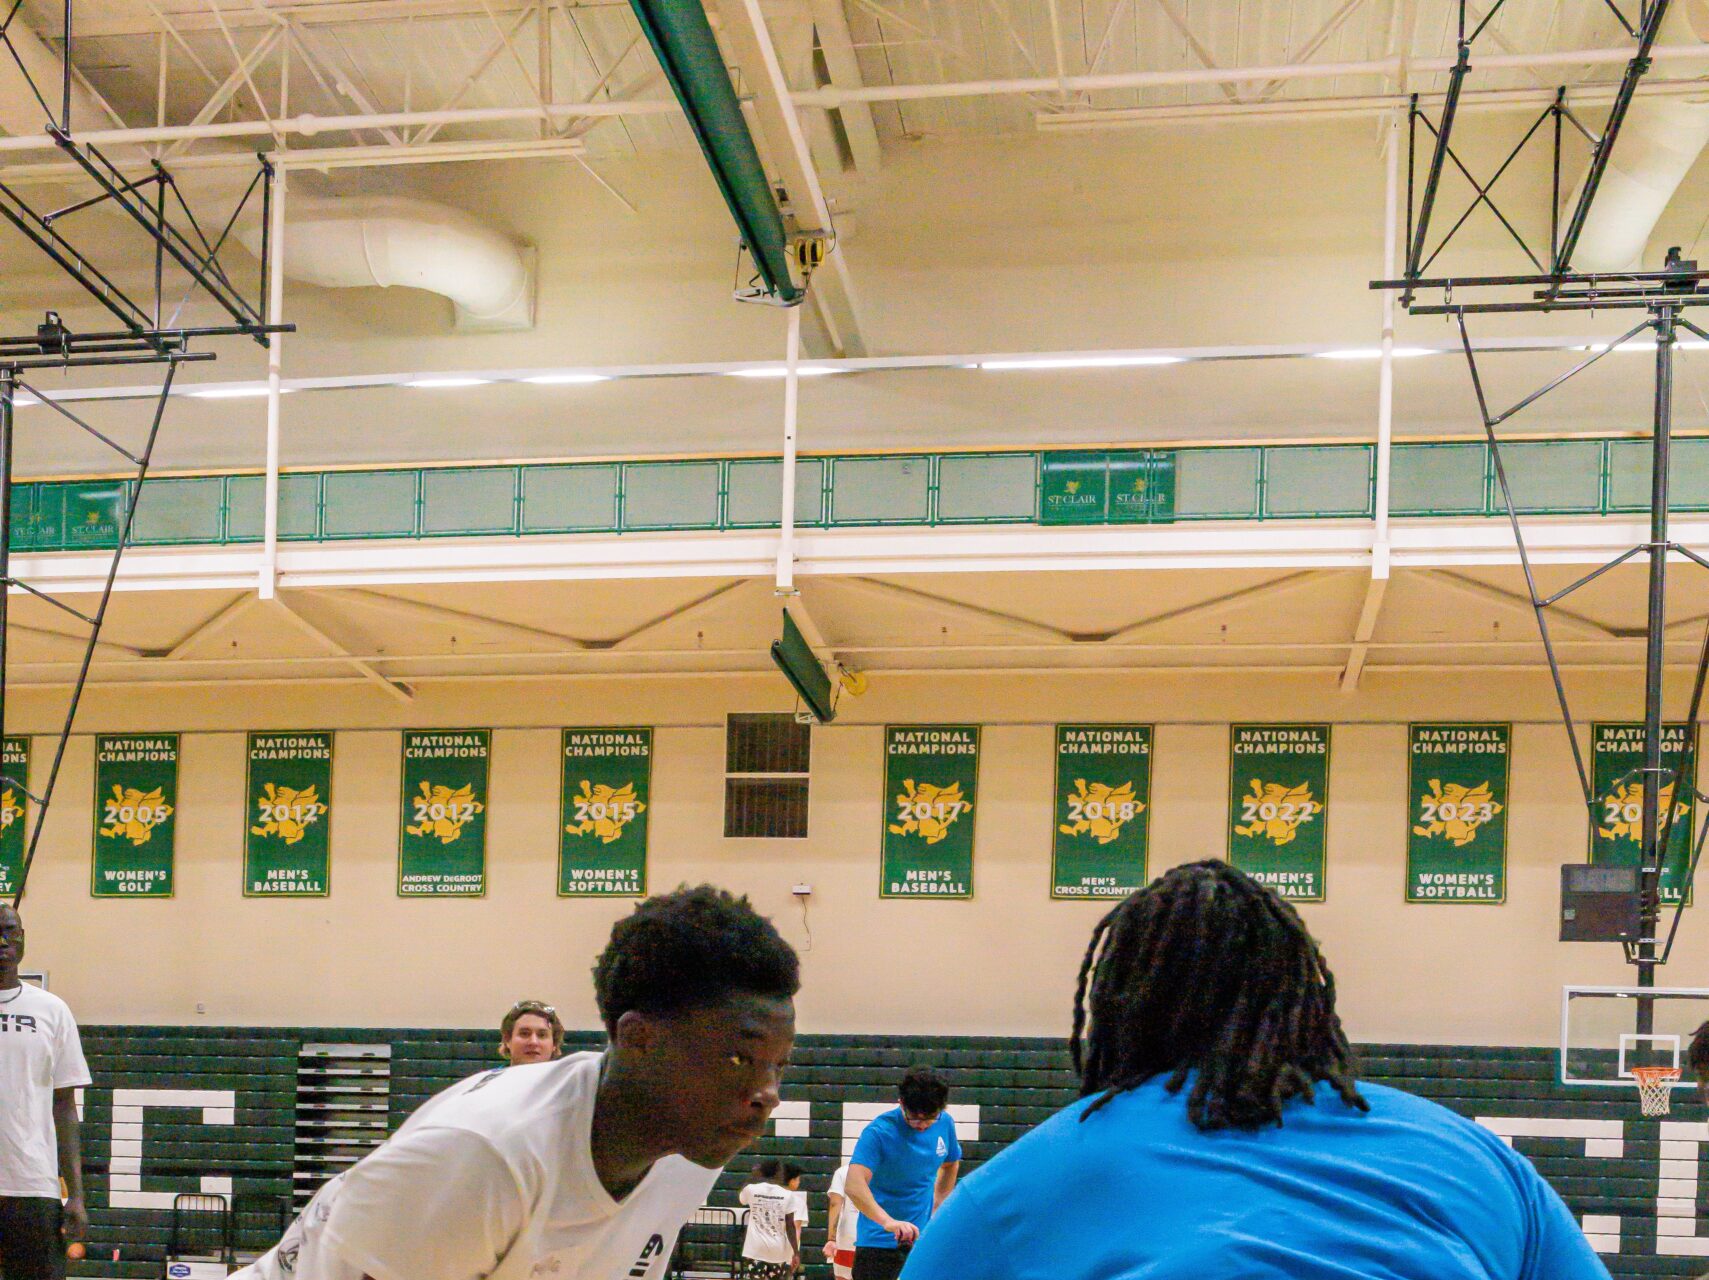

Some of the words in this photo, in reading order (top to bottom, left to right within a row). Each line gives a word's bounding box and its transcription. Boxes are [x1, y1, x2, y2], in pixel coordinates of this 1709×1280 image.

[1062, 495, 1096, 504] CLAIR
[411, 736, 482, 746] NATIONAL
[571, 734, 644, 745] NATIONAL
[895, 732, 970, 742] NATIONAL
[1066, 732, 1143, 742] NATIONAL
[1240, 731, 1320, 742] NATIONAL
[1419, 730, 1500, 742] NATIONAL
[104, 740, 172, 751] NATIONAL
[256, 738, 325, 748] NATIONAL
[1412, 743, 1506, 754] CHAMPIONS
[250, 749, 330, 760] CHAMPIONS
[406, 747, 487, 758] CHAMPIONS
[565, 746, 648, 757] CHAMPIONS
[888, 744, 976, 754] CHAMPIONS
[1059, 744, 1149, 754] CHAMPIONS
[1234, 744, 1326, 754] CHAMPIONS
[99, 751, 176, 762] CHAMPIONS
[103, 806, 167, 823] 2005
[258, 804, 318, 822] 2012
[414, 804, 475, 821] 2012
[574, 802, 636, 821] 2015
[897, 802, 962, 820] 2017
[1067, 802, 1135, 820] 2018
[1241, 802, 1314, 821] 2022
[1420, 802, 1493, 822] 2023
[104, 870, 166, 881] WOMEN'S
[267, 870, 309, 880] MEN'S
[402, 874, 442, 882] ANDREW
[571, 869, 638, 880] WOMEN'S
[906, 870, 952, 881] MEN'S
[1418, 874, 1494, 885] WOMEN'S
[118, 882, 152, 892] GOLF
[254, 881, 321, 892] BASEBALL
[568, 882, 640, 892] SOFTBALL
[1082, 878, 1116, 886] MEN'S
[402, 884, 434, 892] CROSS
[436, 884, 482, 892] COUNTRY
[891, 882, 966, 894] BASEBALL
[1055, 886, 1090, 894] CROSS
[1416, 886, 1496, 898] SOFTBALL
